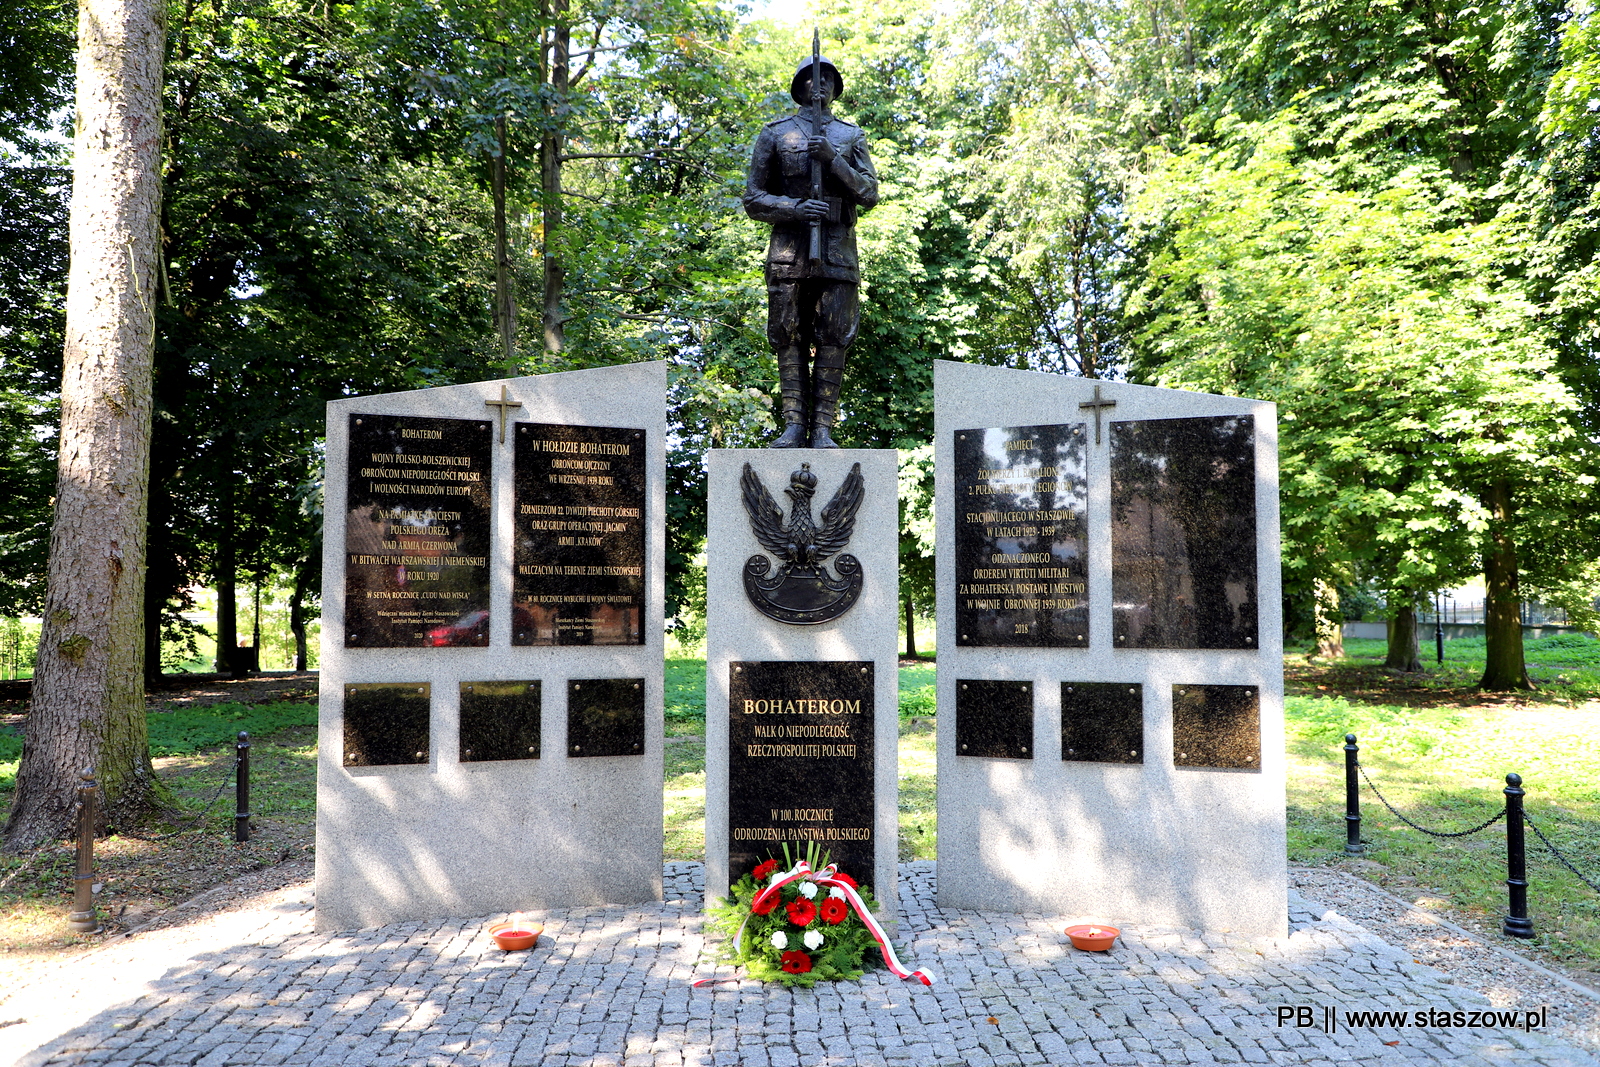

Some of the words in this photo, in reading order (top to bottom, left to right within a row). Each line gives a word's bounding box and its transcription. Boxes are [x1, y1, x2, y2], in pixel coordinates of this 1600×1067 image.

[402, 429, 442, 439] BOHATEROM
[533, 440, 540, 451] W
[542, 441, 578, 453] HOŁDZIE
[580, 443, 630, 455] BOHATEROM
[372, 453, 394, 464] WOJNY
[396, 454, 470, 468] POLSKO-BOLSZEWICKIEJ
[552, 458, 583, 469] OBROŃCOM
[584, 460, 611, 471] OJCZYZNY
[361, 467, 400, 478] OBROŃCOM
[402, 469, 456, 480] NIEPODLEGŁOŚCI
[458, 472, 480, 481] POLSKI
[549, 474, 557, 483] WE
[587, 476, 598, 484] 1939
[598, 476, 614, 486] ROKU
[370, 483, 373, 492] I
[374, 483, 409, 494] WOLNOŚCI
[410, 483, 445, 494] NARODÓW
[446, 486, 472, 496] EUROPY
[969, 486, 974, 495] 2.
[378, 510, 389, 519] NA
[521, 503, 557, 514] ŻOŁNIERZOM
[566, 506, 587, 516] DYWIZJI
[588, 507, 614, 516] PIECHOTY
[614, 506, 640, 519] GÓRSKIEJ
[966, 511, 1026, 524] STACJONUJĄCEGO
[1028, 512, 1035, 521] W
[1036, 510, 1075, 521] STASZOWIE
[390, 526, 427, 535] POLSKIEGO
[428, 525, 450, 537] ORĘŻA
[532, 520, 547, 530] ORAZ
[549, 521, 567, 530] GRUPY
[568, 522, 603, 533] OPERACYJNEJ
[987, 528, 994, 537] W
[995, 527, 1021, 537] LATACH
[1023, 527, 1036, 536] 1923
[1042, 526, 1055, 536] 1939
[382, 541, 396, 549] NAD
[399, 542, 420, 552] ARMIĄ
[422, 542, 458, 552] CZERWONĄ
[558, 537, 574, 546] ARMII
[352, 556, 358, 564] W
[359, 556, 389, 564] BITWACH
[391, 556, 440, 567] WARSZAWSKIEJ
[445, 556, 486, 568] NIEMEŃSKIEJ
[992, 552, 1050, 563] ODZNACZONEGO
[407, 572, 426, 580] ROKU
[427, 572, 440, 580] 1920
[520, 566, 554, 576] WALCZĄCYM
[555, 566, 563, 575] NA
[564, 566, 586, 575] TERENIE
[587, 566, 602, 575] ZIEMI
[604, 566, 641, 578] STASZOWSKIEJ
[974, 568, 1006, 579] ORDEREM
[1008, 568, 1036, 578] VIRTUTI
[1038, 568, 1070, 578] MILITARI
[960, 584, 969, 594] ZA
[970, 584, 1014, 595] BOHATERSKĄ
[1016, 583, 1048, 595] POSTAWĘ
[1050, 584, 1052, 593] I
[1054, 583, 1085, 596] MĘSTWO
[607, 595, 632, 604] ŚWIATOWEJ
[967, 600, 974, 609] W
[975, 599, 1000, 611] WOJNIE
[1004, 599, 1041, 611] OBRONNEJ
[1042, 599, 1055, 609] 1939
[1057, 599, 1076, 609] ROKU
[1015, 624, 1028, 633] 2018
[744, 699, 861, 714] BOHATEROM
[755, 725, 777, 737] WALK
[778, 725, 784, 737] O
[786, 722, 850, 738] NIEPODLEGŁOŚĆ
[748, 744, 820, 759] RZECZYPOSPOLITEJ
[822, 745, 856, 759] POLSKIEJ
[771, 809, 779, 821] W
[781, 809, 793, 821] 100.
[795, 808, 833, 823] ROCZNICĘ
[734, 828, 786, 840] ODRODZENIA
[788, 825, 824, 840] PAŃSTWA
[827, 828, 870, 840] POLSKIEGO
